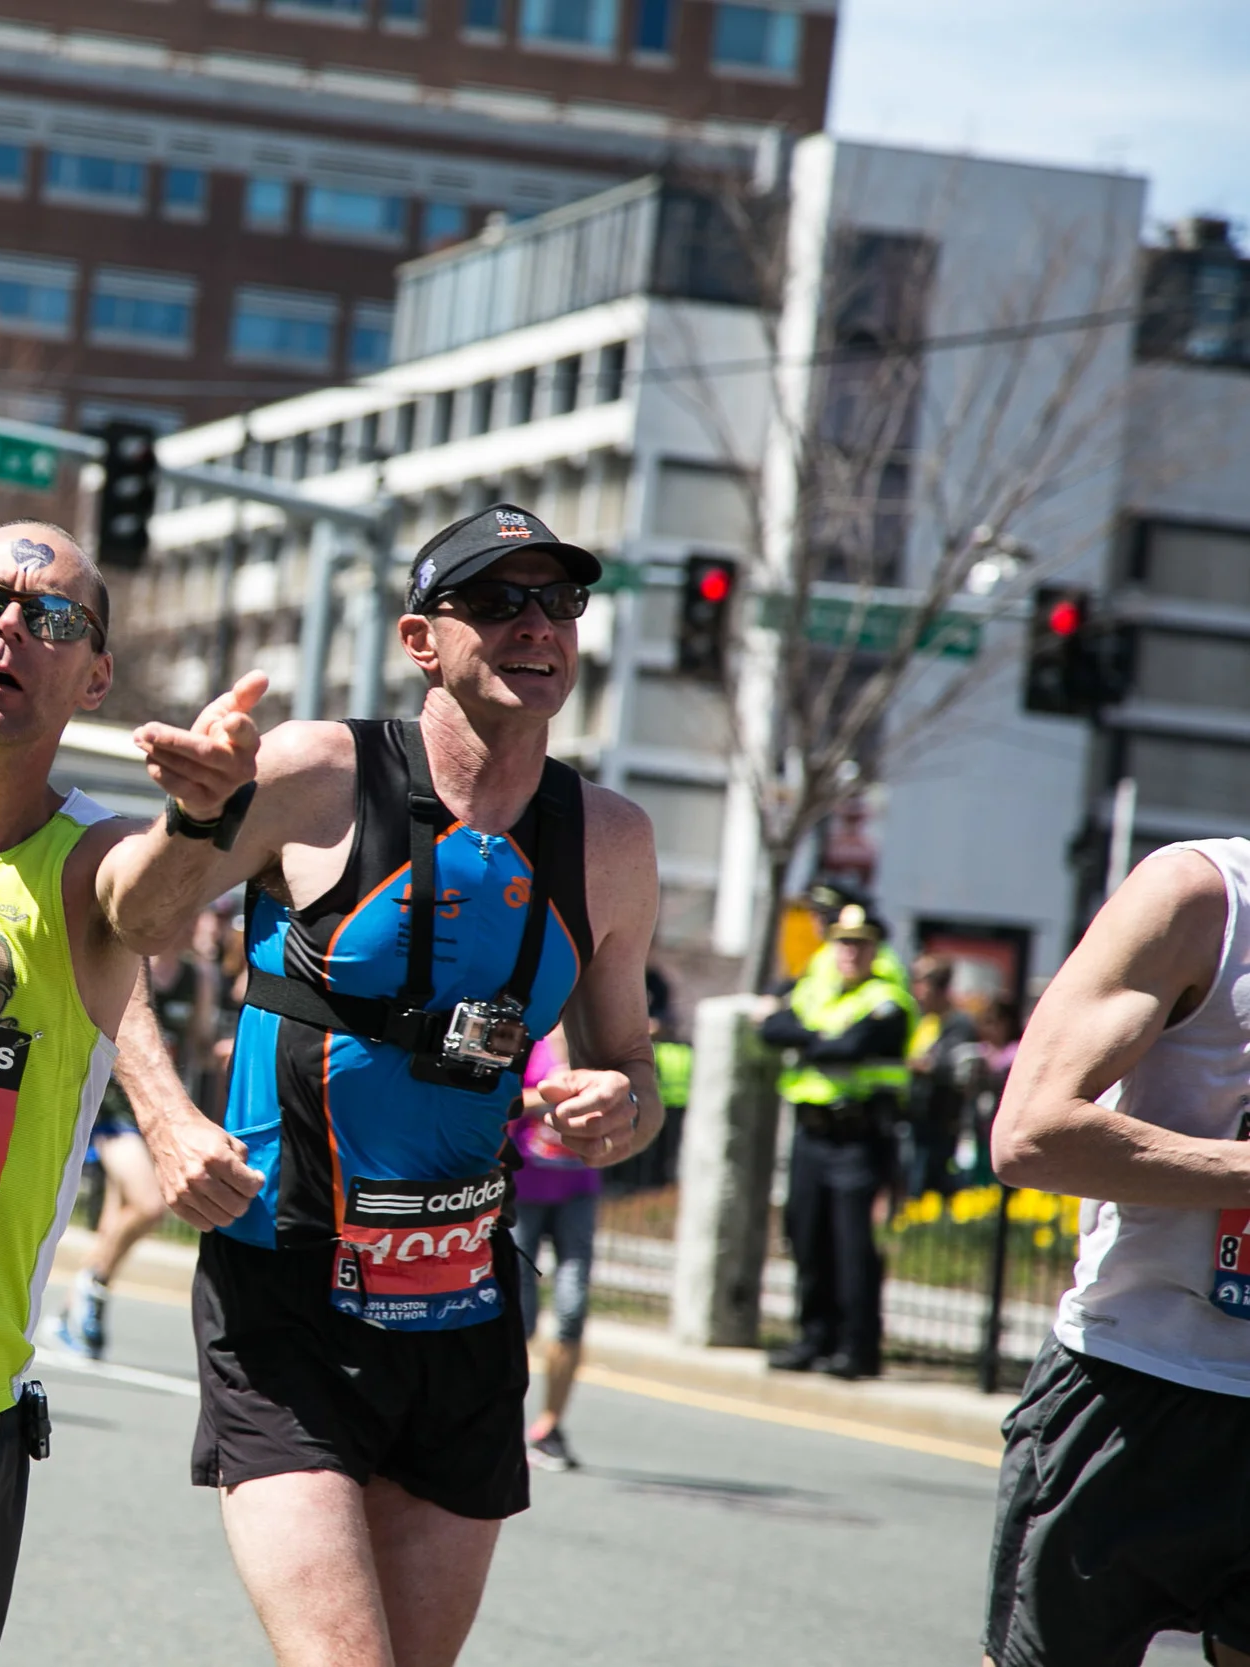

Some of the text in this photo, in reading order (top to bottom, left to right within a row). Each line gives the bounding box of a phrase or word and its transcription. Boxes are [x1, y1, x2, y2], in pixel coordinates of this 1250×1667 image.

[496, 511, 524, 520] RACE
[427, 1176, 506, 1212] adidas
[1221, 1236, 1239, 1268] 8
[339, 1260, 358, 1288] 5
[388, 1302, 428, 1311] BOSTON
